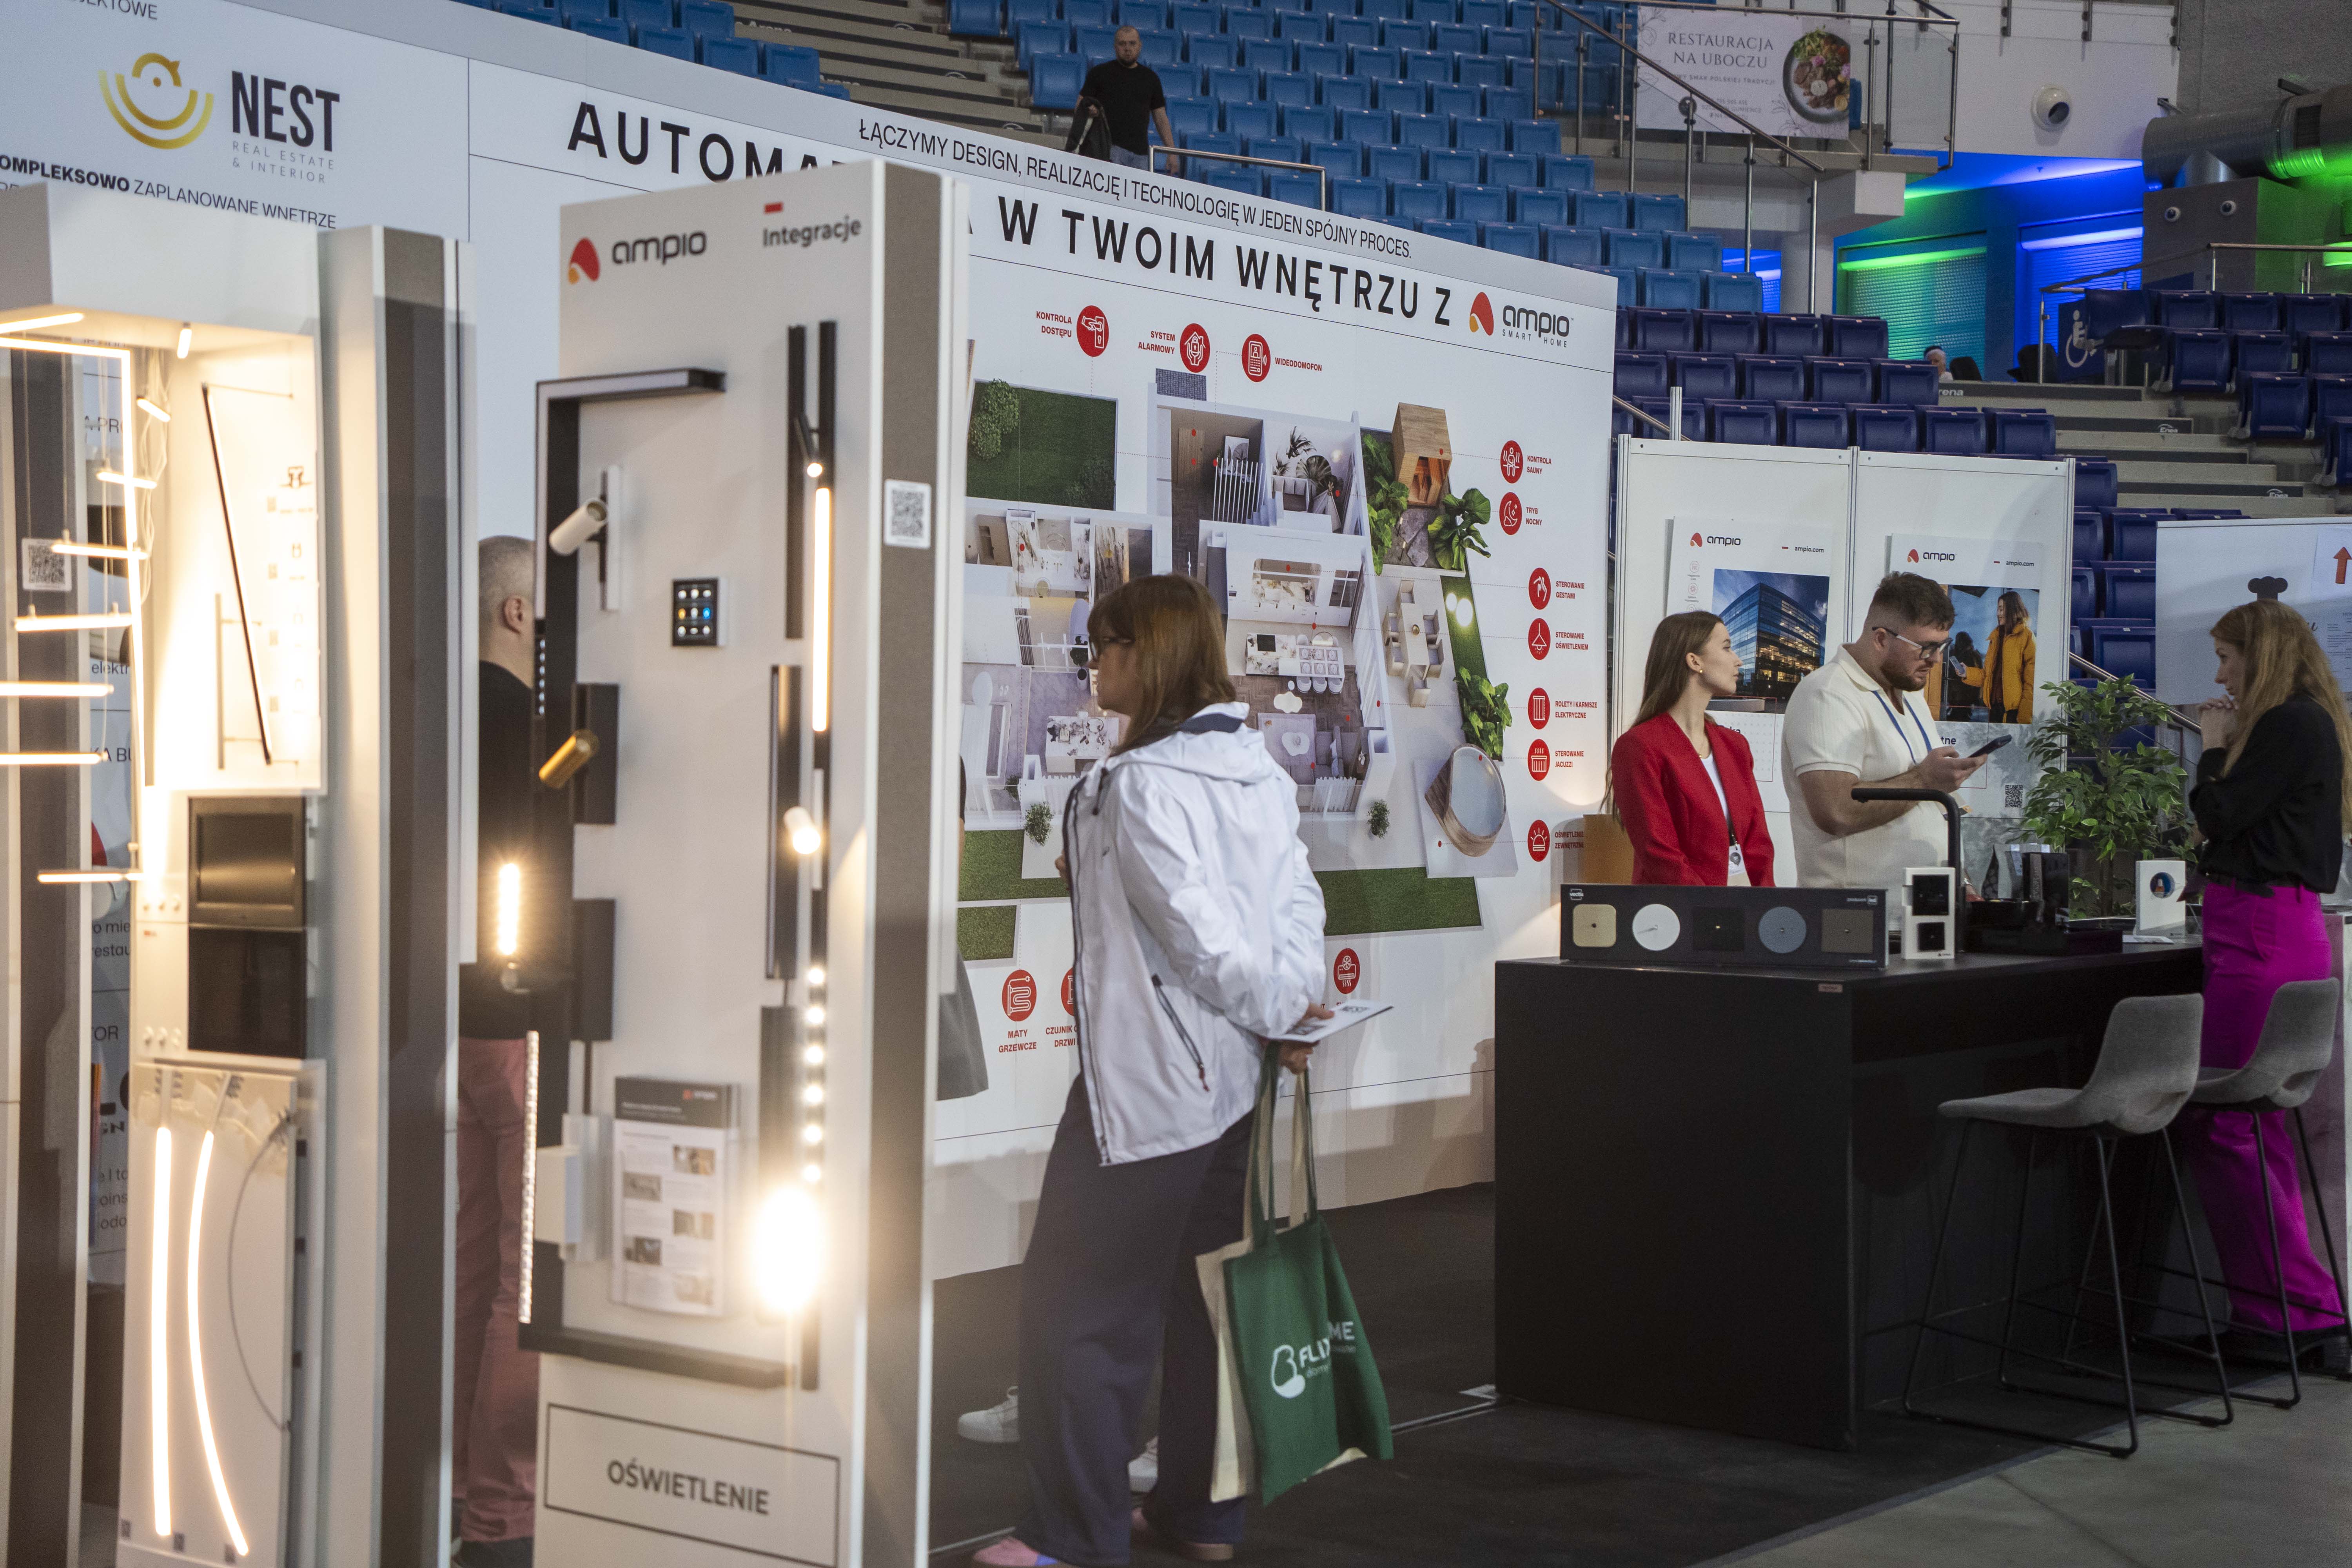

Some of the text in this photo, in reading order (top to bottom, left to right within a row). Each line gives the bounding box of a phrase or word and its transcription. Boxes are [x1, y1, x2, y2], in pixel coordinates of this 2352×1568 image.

[1668, 32, 1774, 51] RESTAURACJA
[1674, 51, 1768, 69] NA UBOCZU
[232, 70, 340, 152] NEST
[233, 141, 334, 170] REAL ESTATE
[232, 157, 325, 184] & INTERIOR
[859, 118, 1412, 259] ŁĄCZYMY DESIGN, REALIZACJĘ I TECHNOLOGIĘ W JEDEN SPÓJNY PROCES.
[134, 179, 259, 215] ZAPLANOWANE
[762, 215, 862, 248] Integracje
[611, 230, 708, 266] ampio
[998, 195, 1451, 327] W TWOIM WNĘTRZU Z
[1036, 311, 1072, 325] KONTROLA
[1041, 325, 1072, 338] DOSTĘPU
[1151, 330, 1175, 341] SYSTEM
[1502, 329, 1567, 348] SMART HOME
[1138, 341, 1175, 354] ALARMOWY
[1275, 358, 1322, 372] WIDEODOMOFON
[1527, 455, 1552, 465] KONTROLA
[1706, 535, 1741, 547] ampio
[1923, 551, 1955, 562] ampio
[1556, 581, 1584, 589] STEROWANIE
[1555, 641, 1588, 650] OŚWIETLENIEM
[1008, 1029, 1028, 1038] MATY
[1045, 1025, 1073, 1035] CZUJNIK
[998, 1042, 1037, 1053] GRZEWCZE
[1054, 1038, 1076, 1047] DRZWI
[606, 1456, 770, 1516] OŚWIETLENIE
